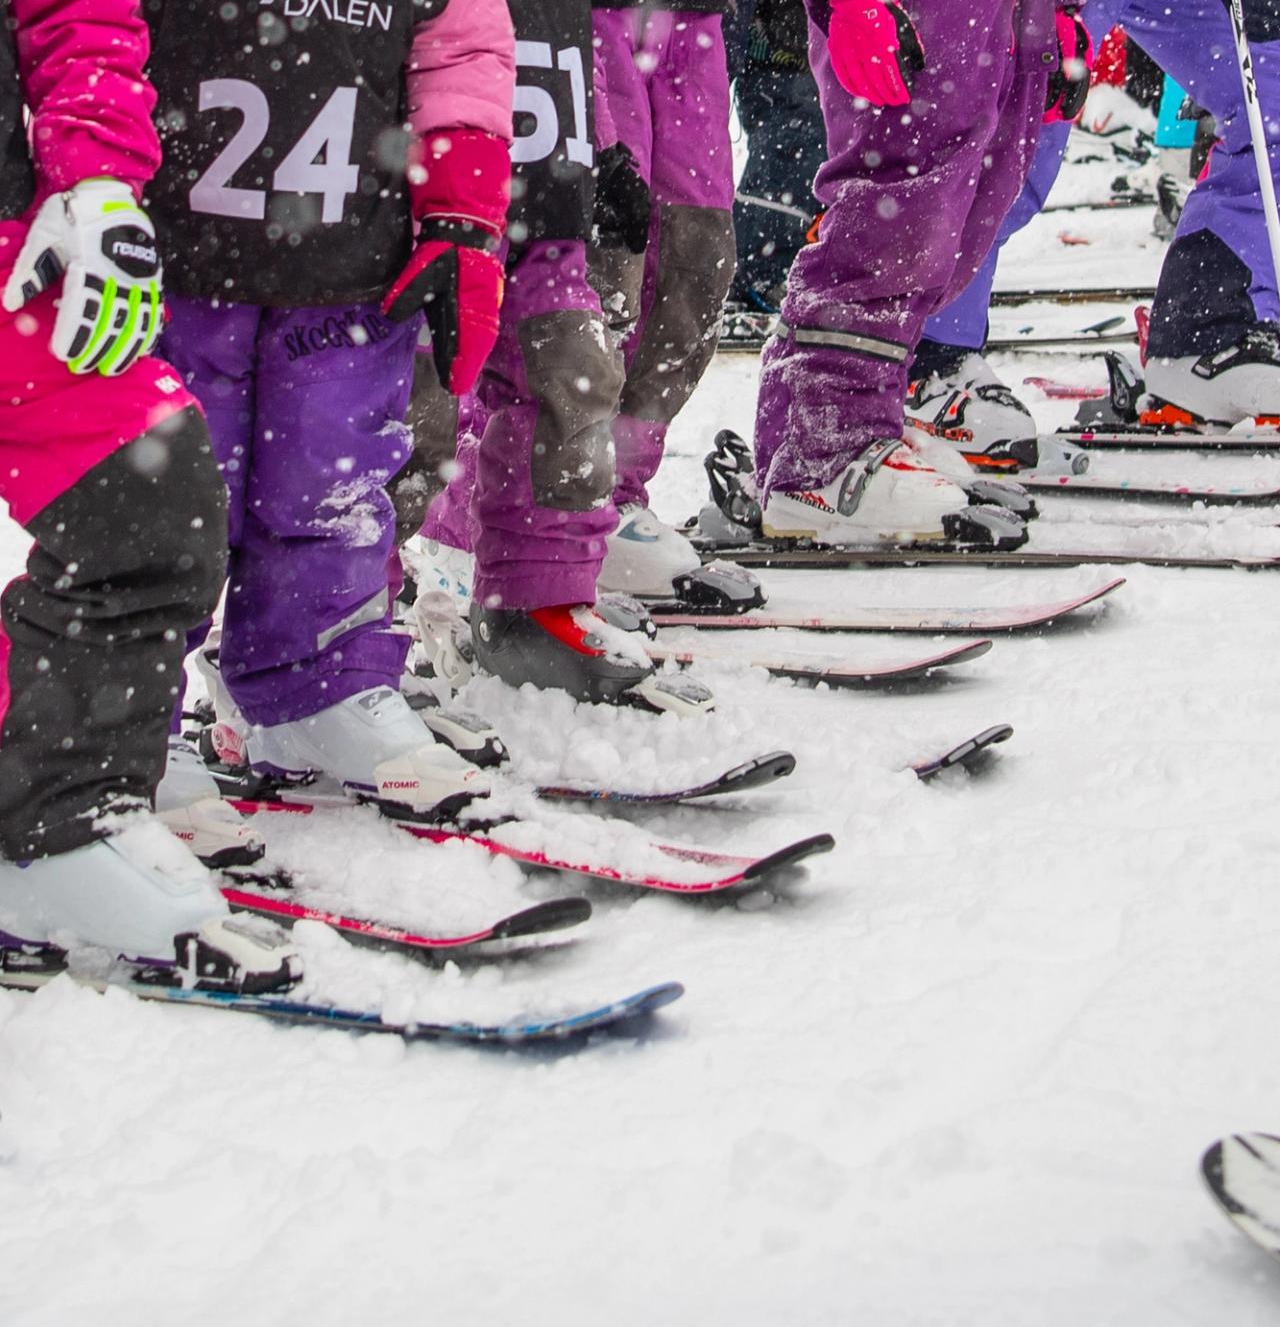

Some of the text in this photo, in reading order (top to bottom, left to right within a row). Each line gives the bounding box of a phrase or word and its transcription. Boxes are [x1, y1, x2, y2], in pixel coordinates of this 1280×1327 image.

[188, 77, 360, 224] 24
[112, 241, 157, 264] reusch
[382, 780, 420, 789] ATOMIC
